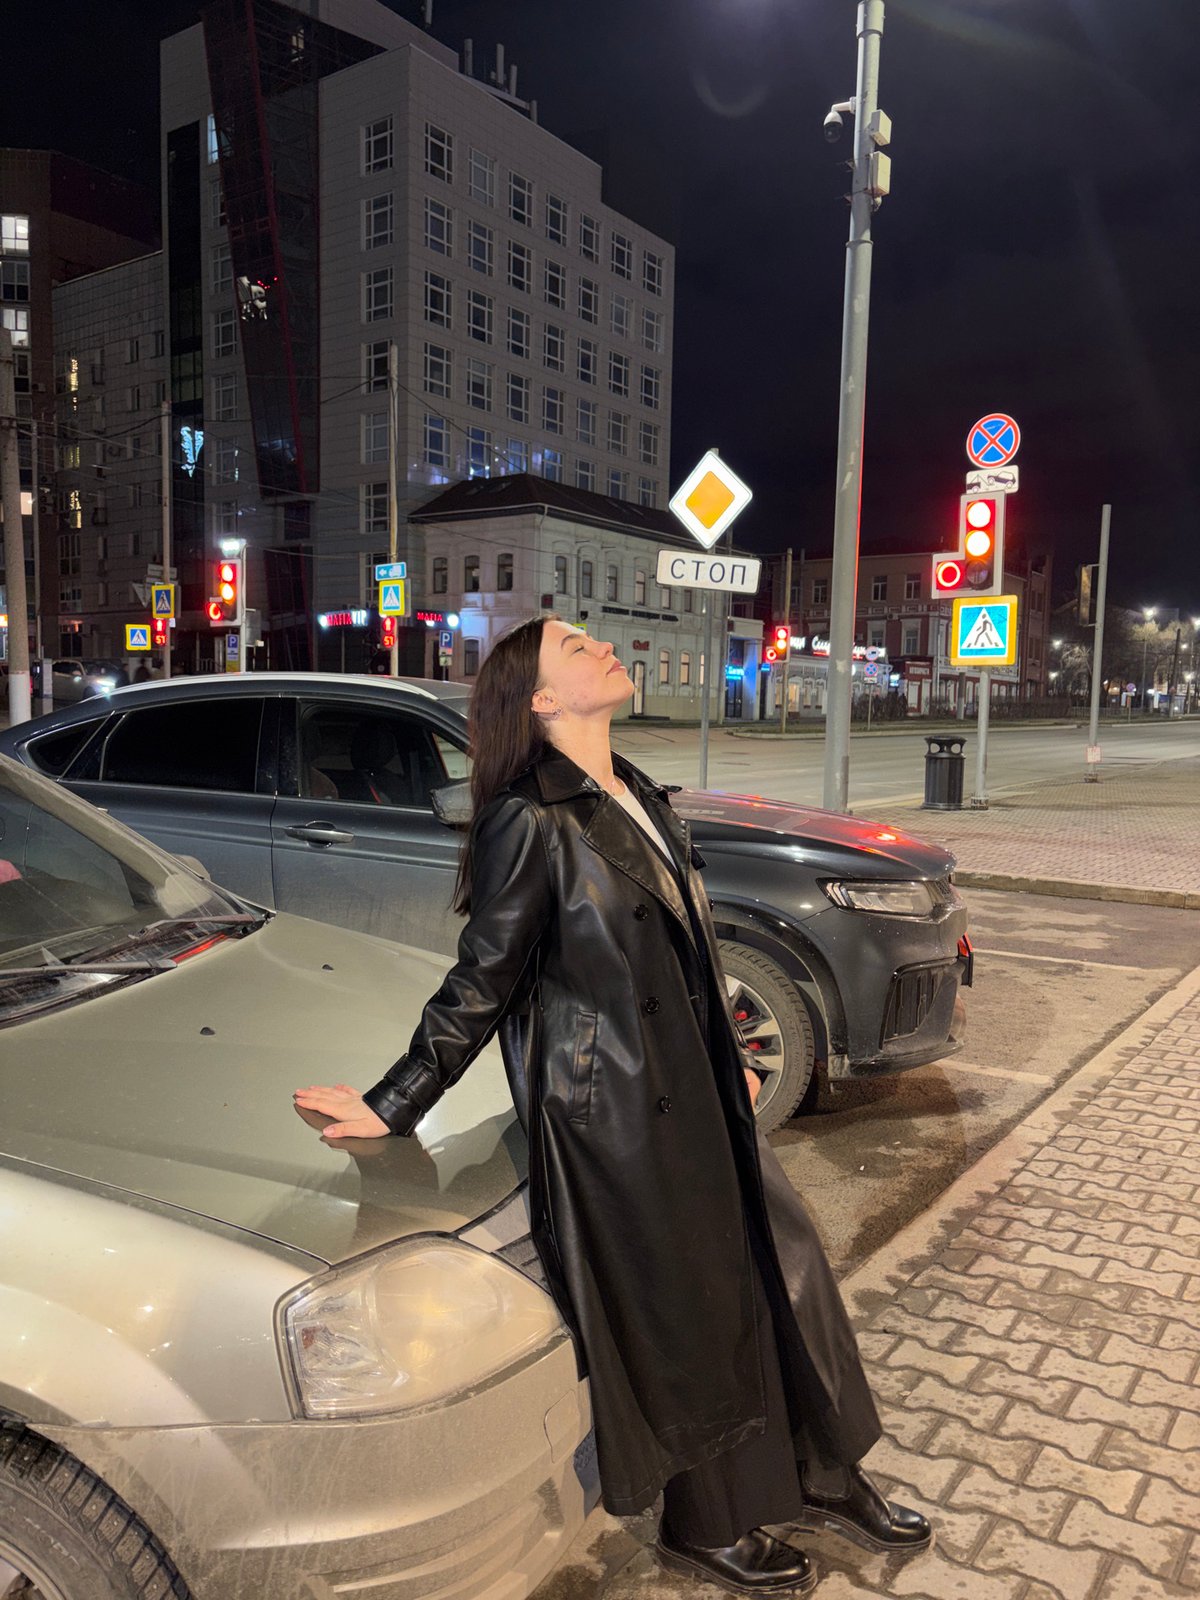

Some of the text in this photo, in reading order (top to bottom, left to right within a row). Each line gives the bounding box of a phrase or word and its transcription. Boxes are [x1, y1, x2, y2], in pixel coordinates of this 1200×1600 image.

[670, 558, 746, 586] СТОП
[326, 609, 367, 627] MAFIA VIP
[417, 612, 442, 622] MAFIA
